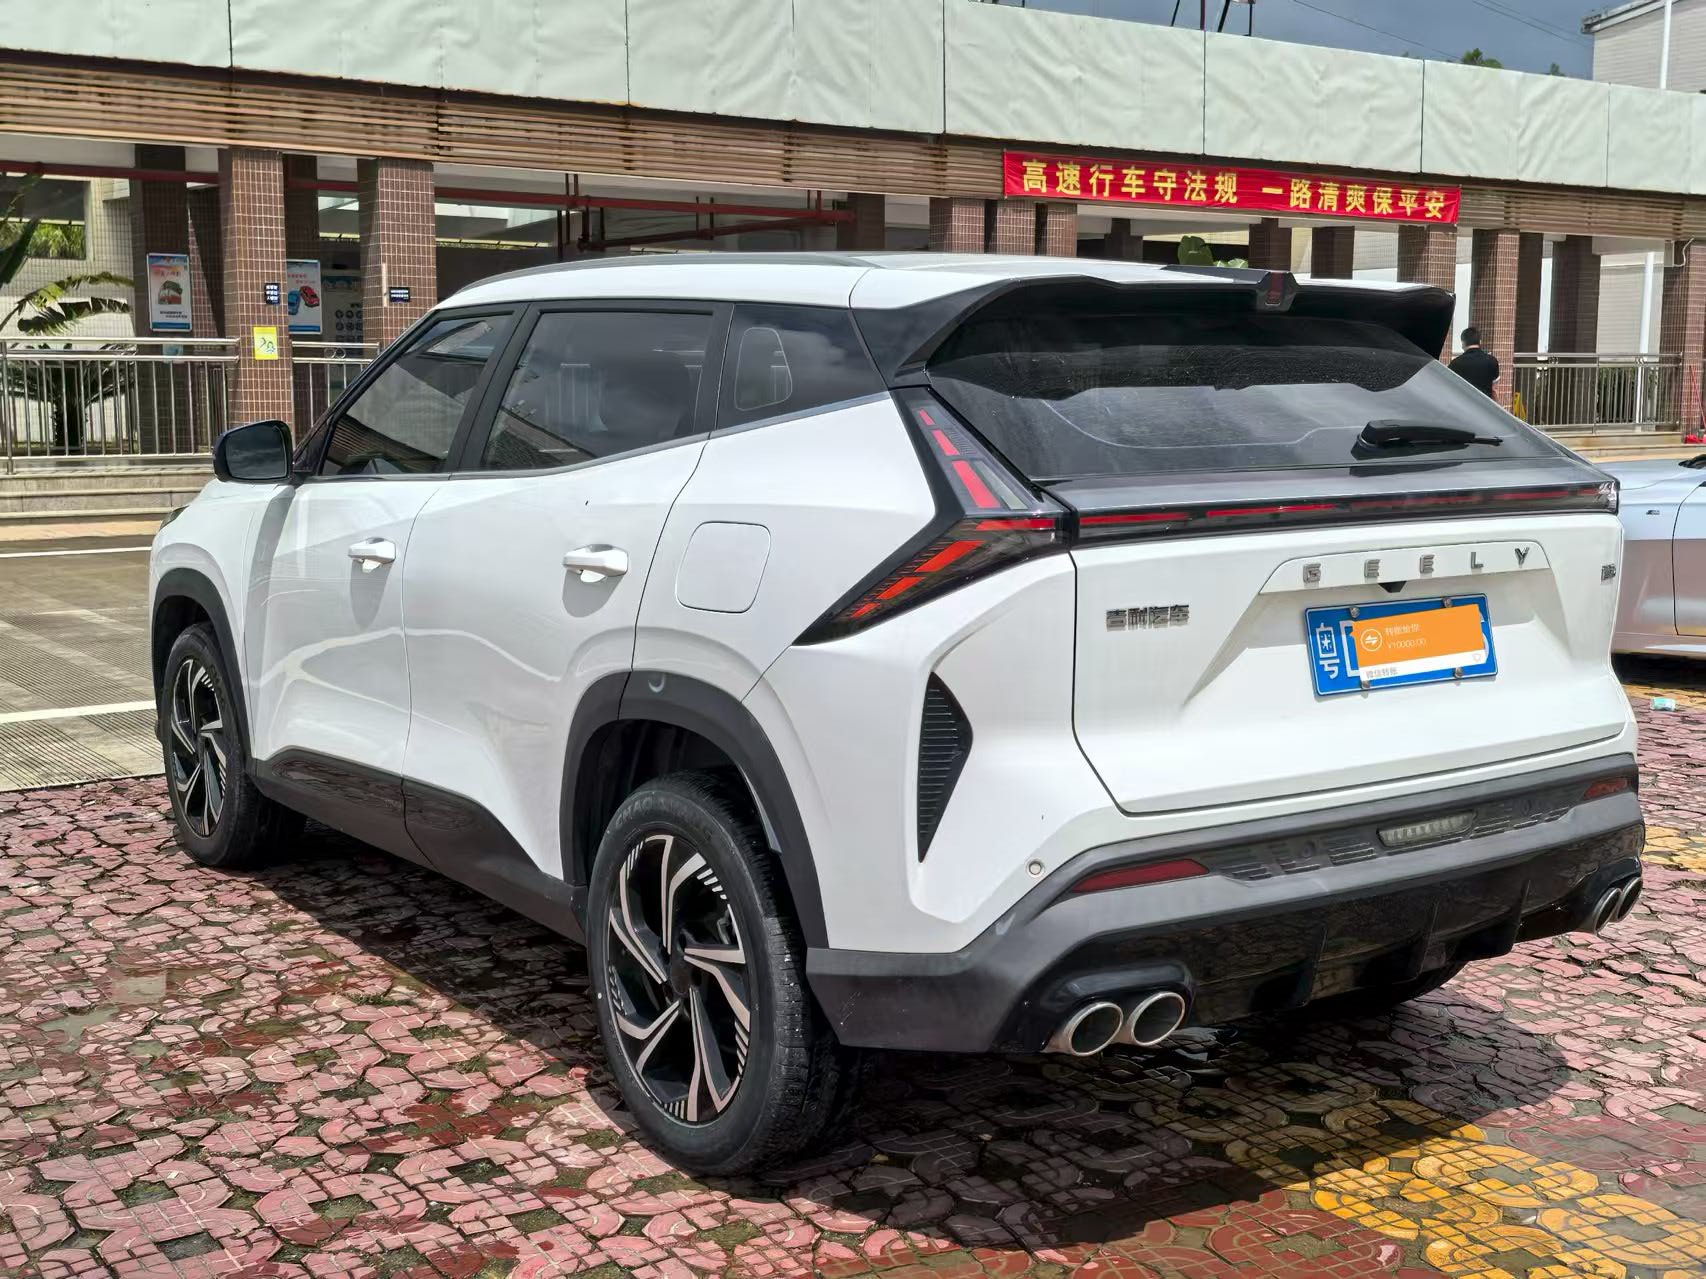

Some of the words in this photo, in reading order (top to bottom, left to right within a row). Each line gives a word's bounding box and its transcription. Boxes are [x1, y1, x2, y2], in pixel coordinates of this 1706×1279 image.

[1022, 159, 1237, 203] 高速行车守法规
[1261, 178, 1445, 218] 一路清爽保平安
[1303, 547, 1530, 583] GEELY
